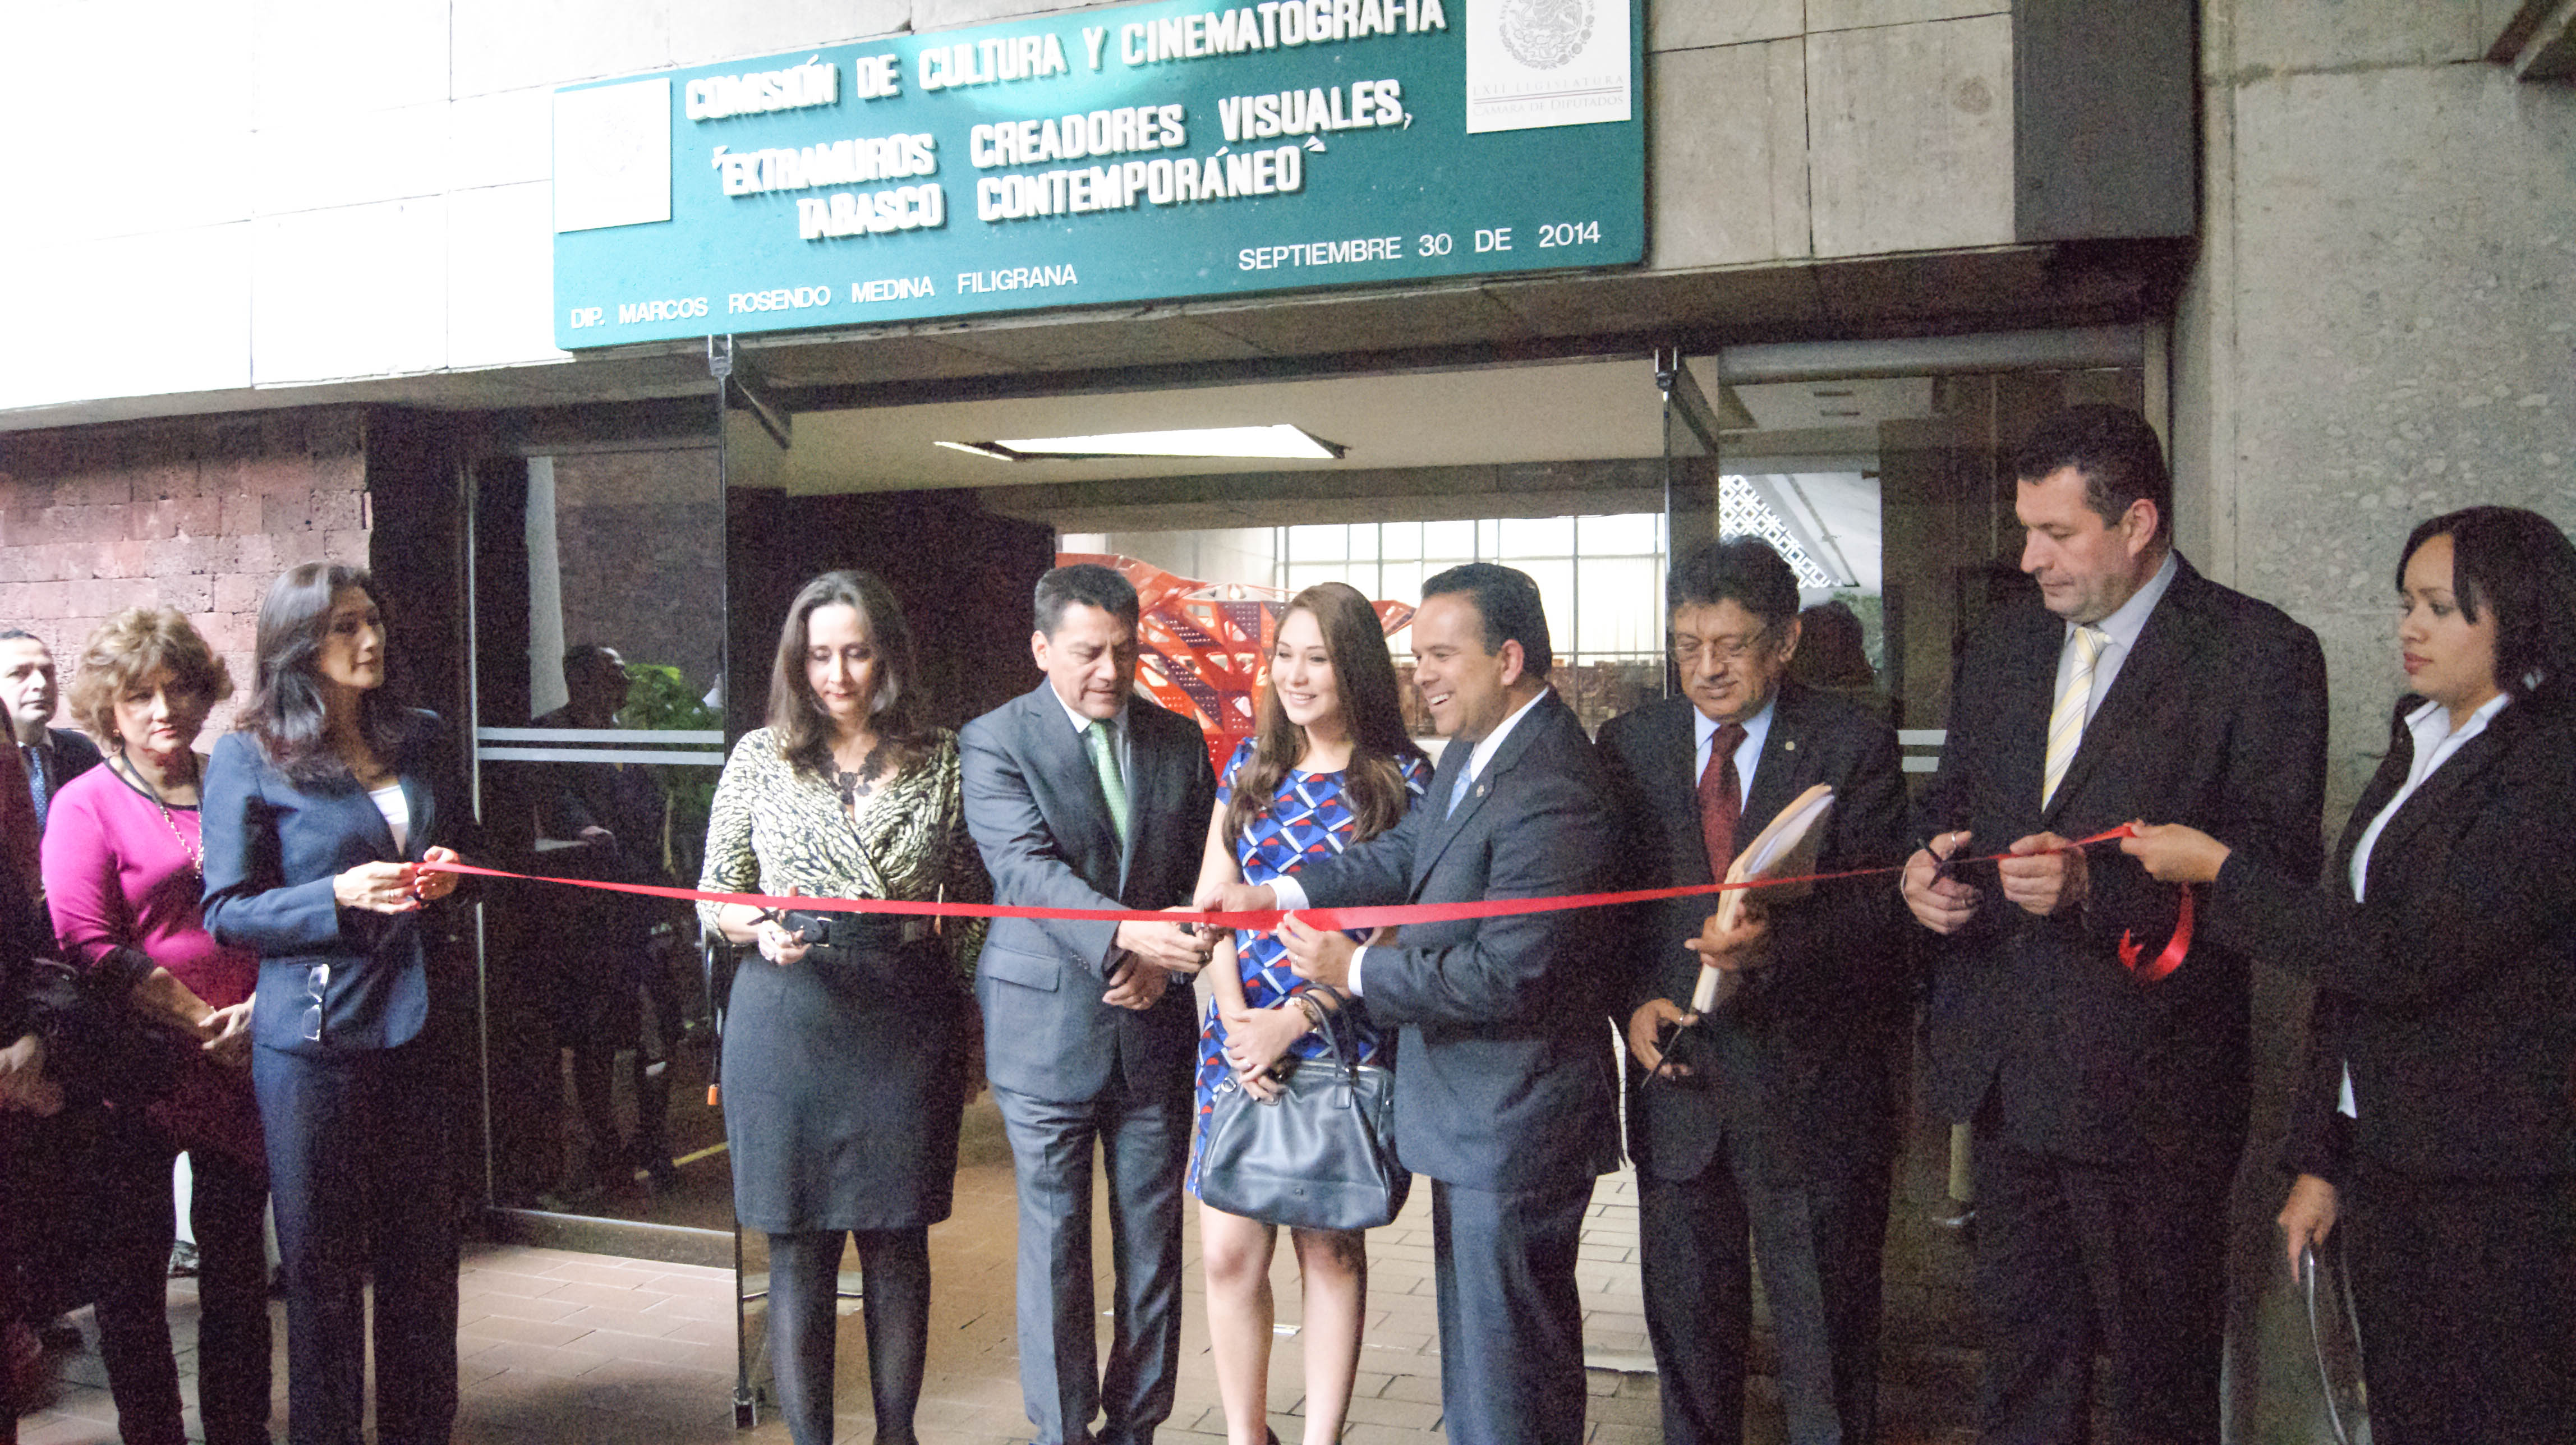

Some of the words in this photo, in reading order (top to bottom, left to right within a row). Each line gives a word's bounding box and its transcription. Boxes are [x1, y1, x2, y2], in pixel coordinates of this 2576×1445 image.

[686, 54, 838, 120] COMISIÓN
[856, 54, 899, 99] DE
[918, 33, 1067, 91] CULTURA
[1083, 27, 1107, 70] Y
[1516, 76, 1623, 93] LEGISLATURA
[970, 108, 1186, 168] CREADORES
[1218, 79, 1413, 141] VISUALES,
[1551, 95, 1623, 111] DIPUTADOS
[796, 183, 945, 240] TABASCO
[1239, 236, 1402, 270] SEPTIEMBRE
[1418, 233, 1453, 257] 30
[1474, 228, 1513, 253] DE
[1539, 221, 1602, 248] 2014
[571, 307, 605, 329] DIP.
[619, 297, 709, 324] MARCOS
[729, 286, 831, 314] ROSENDO
[852, 276, 935, 303] MEDINA
[958, 264, 1078, 294] FILIGRANA
